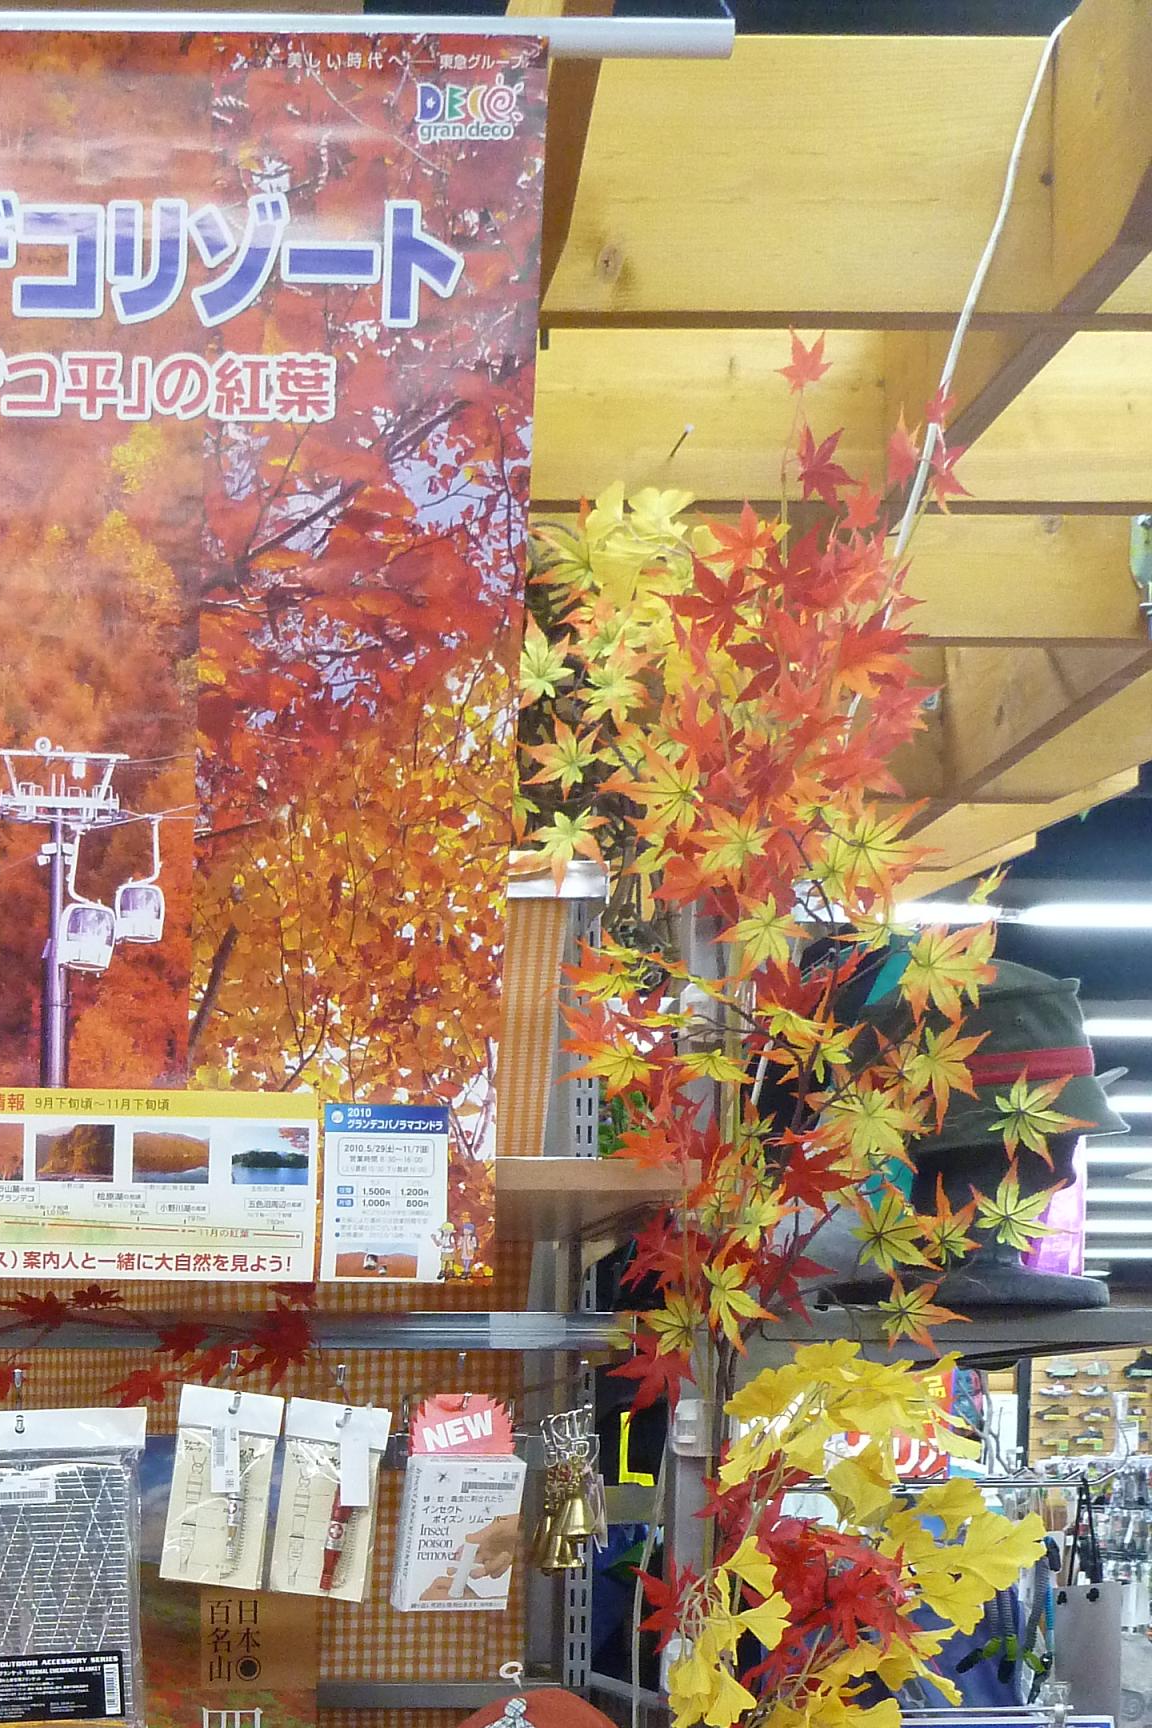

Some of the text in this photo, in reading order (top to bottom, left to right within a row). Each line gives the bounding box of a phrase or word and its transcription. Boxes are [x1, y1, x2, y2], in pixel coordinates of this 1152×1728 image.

[416, 74, 524, 124] DECO
[419, 121, 513, 143] gran deco
[348, 1108, 372, 1117] 2010
[347, 1119, 443, 1131] グランデコパノラマゴンドラ
[423, 1410, 493, 1452] NEW
[422, 1505, 463, 1514] インセクト
[420, 1523, 450, 1536] Insect
[418, 1539, 453, 1551] poison
[417, 1551, 459, 1561] remover
[236, 1599, 261, 1653] 日本
[206, 1598, 233, 1682] 百名山
[0, 1659, 39, 1668] OUTDOOR
[41, 1657, 87, 1666] ACCESSORY
[90, 1655, 119, 1663] SERIES
